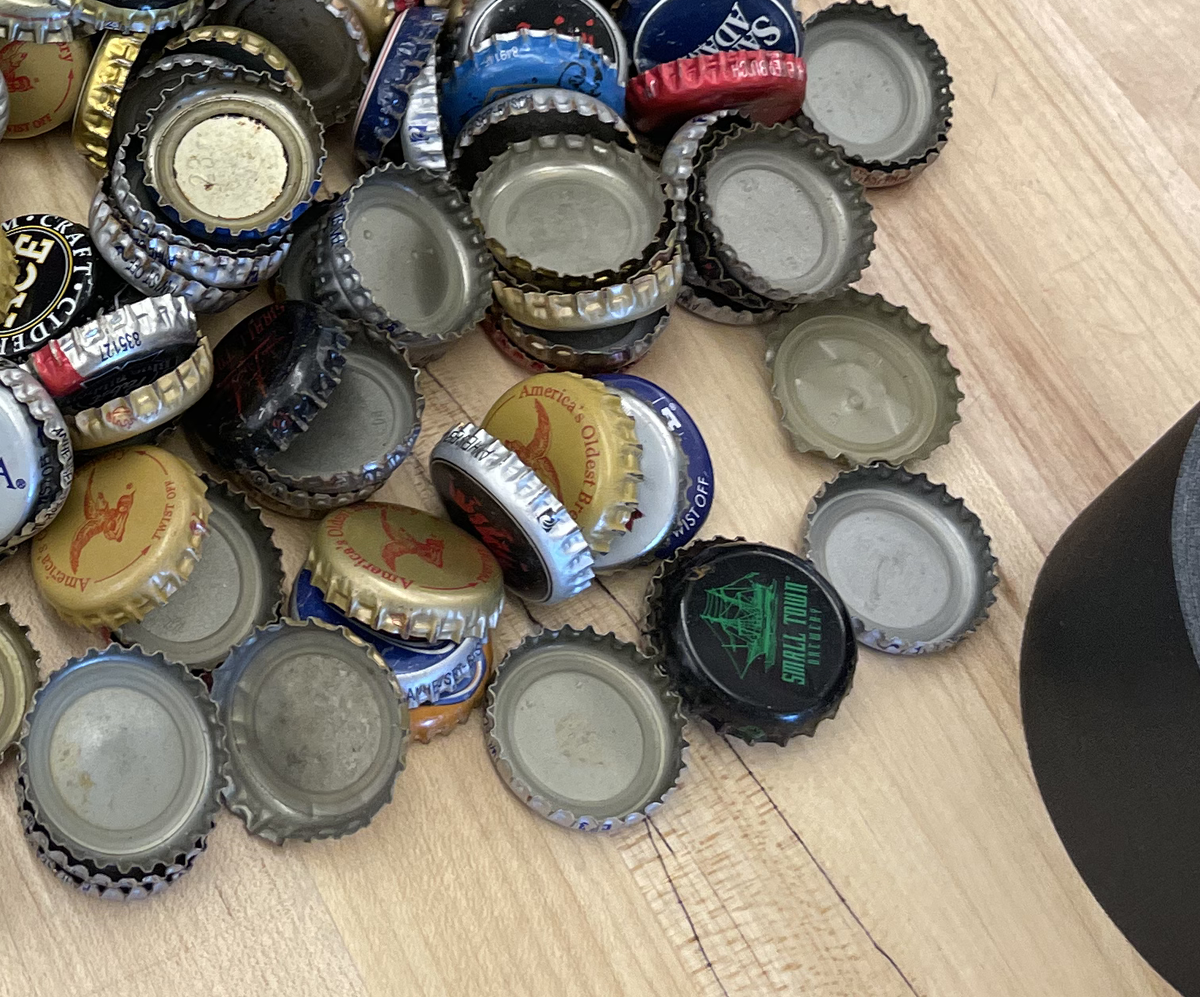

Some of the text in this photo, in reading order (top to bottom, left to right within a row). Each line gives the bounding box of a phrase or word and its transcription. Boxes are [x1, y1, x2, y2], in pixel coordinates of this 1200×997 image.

[6, 119, 30, 135] WIST
[39, 214, 93, 277] CRAFT
[519, 385, 586, 424] America's
[580, 424, 601, 488] Oldest
[151, 503, 175, 541] TWIST
[672, 476, 710, 539] WIST OFF
[36, 543, 92, 593] America's
[336, 537, 415, 590] America's
[780, 580, 809, 687] SMALL TOWN
[806, 606, 824, 667] BREWERY
